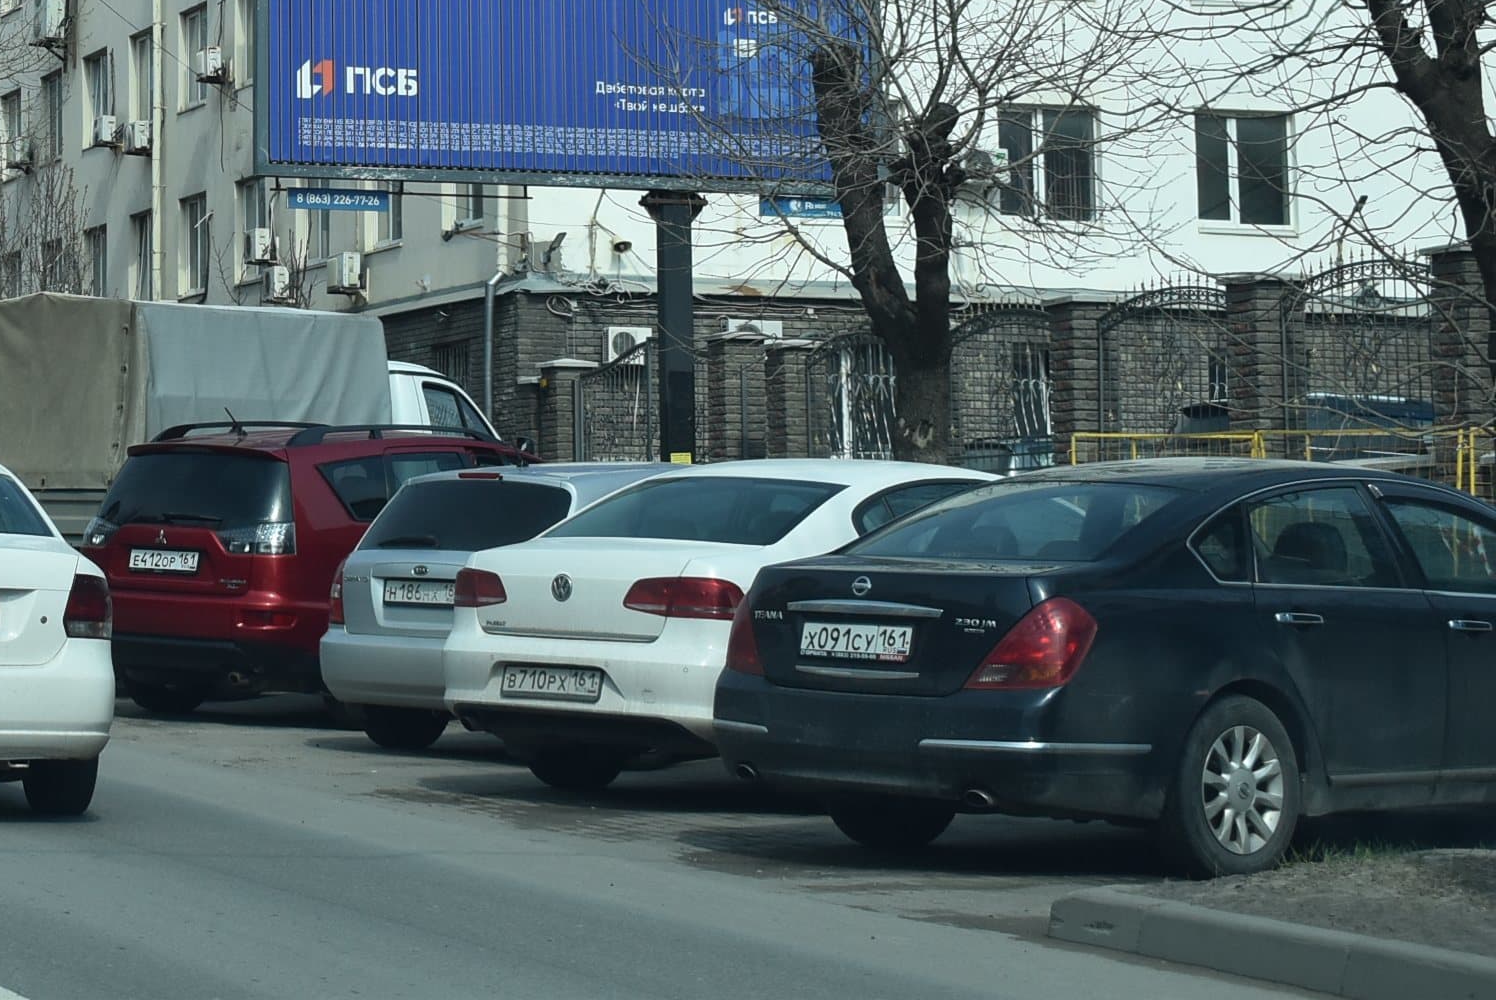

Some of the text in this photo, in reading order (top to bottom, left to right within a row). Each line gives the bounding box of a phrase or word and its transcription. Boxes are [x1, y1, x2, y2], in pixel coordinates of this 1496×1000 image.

[346, 66, 419, 96] ПСБ
[595, 81, 665, 96] Дебетовая
[297, 193, 380, 206] 8 (863) 226-77-26
[806, 627, 906, 651] Х091СУ 161
[507, 669, 596, 691] В710РХ 161
